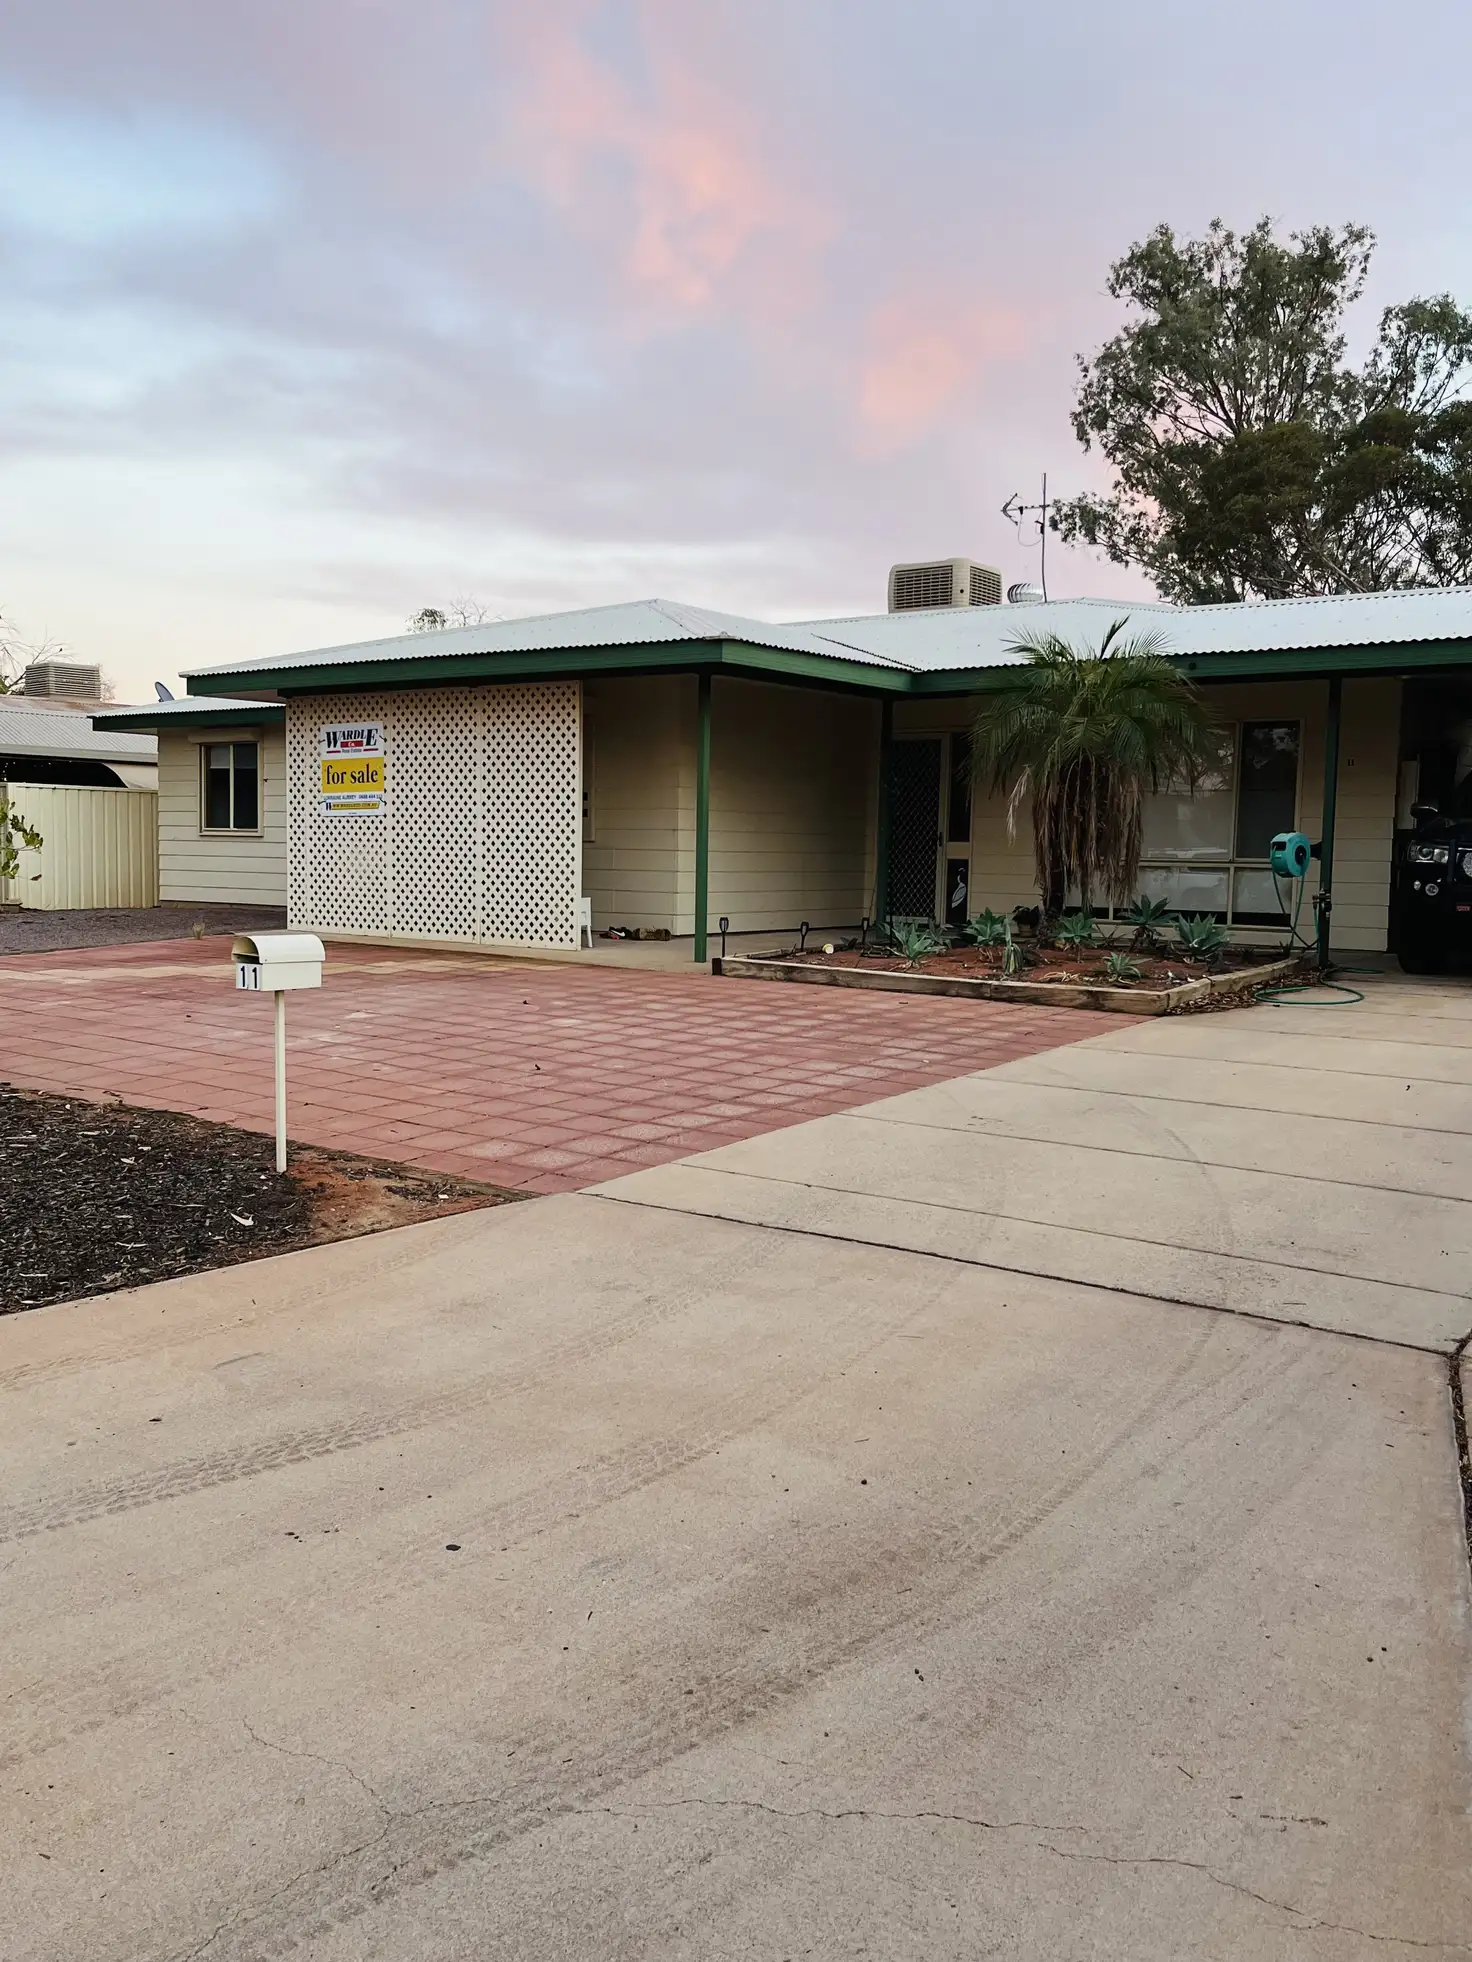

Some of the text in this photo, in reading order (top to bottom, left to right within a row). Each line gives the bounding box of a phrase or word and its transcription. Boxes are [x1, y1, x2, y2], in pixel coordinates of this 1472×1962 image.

[325, 728, 379, 749] WARDLE
[326, 762, 378, 785] for sale
[240, 965, 258, 989] 11
